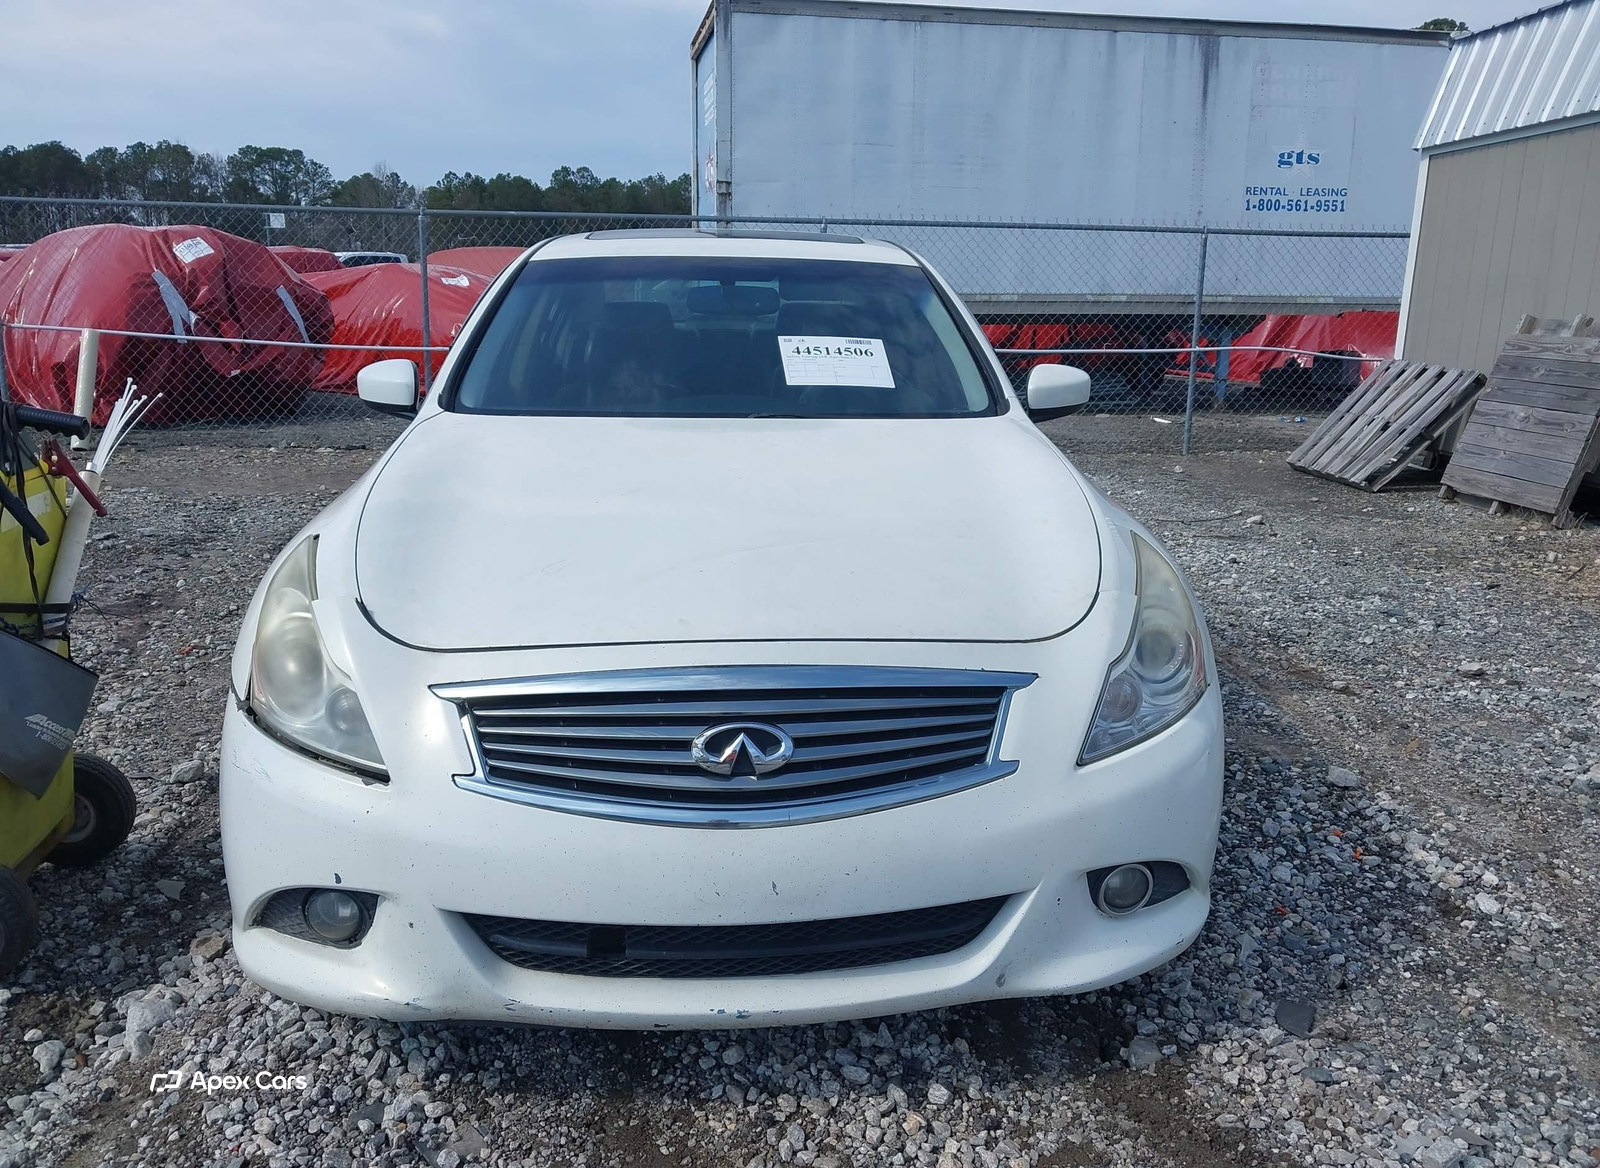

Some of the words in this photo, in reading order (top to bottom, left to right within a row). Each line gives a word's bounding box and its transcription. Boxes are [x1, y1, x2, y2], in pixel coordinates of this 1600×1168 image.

[1277, 149, 1320, 168] gts
[1245, 187, 1288, 196] RENTAL
[1300, 188, 1347, 197] LEASING
[1245, 199, 1345, 212] 1-800-561-9551
[792, 346, 874, 358] 44514506
